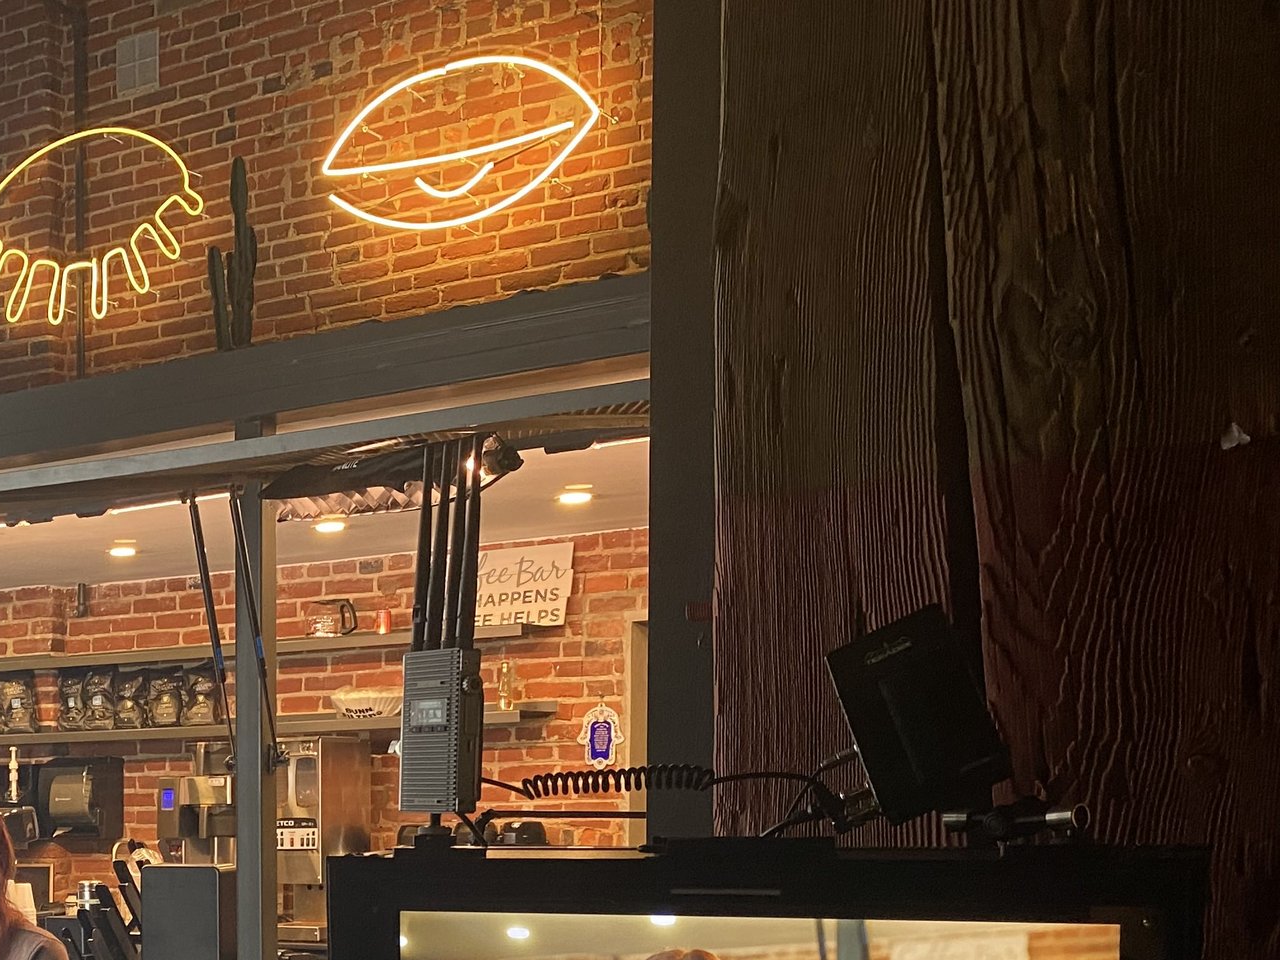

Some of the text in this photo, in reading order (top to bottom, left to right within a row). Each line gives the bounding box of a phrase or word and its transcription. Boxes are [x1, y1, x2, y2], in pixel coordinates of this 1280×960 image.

[515, 556, 567, 588] Bar
[500, 608, 561, 626] HELPS
[345, 707, 373, 715] BUNN
